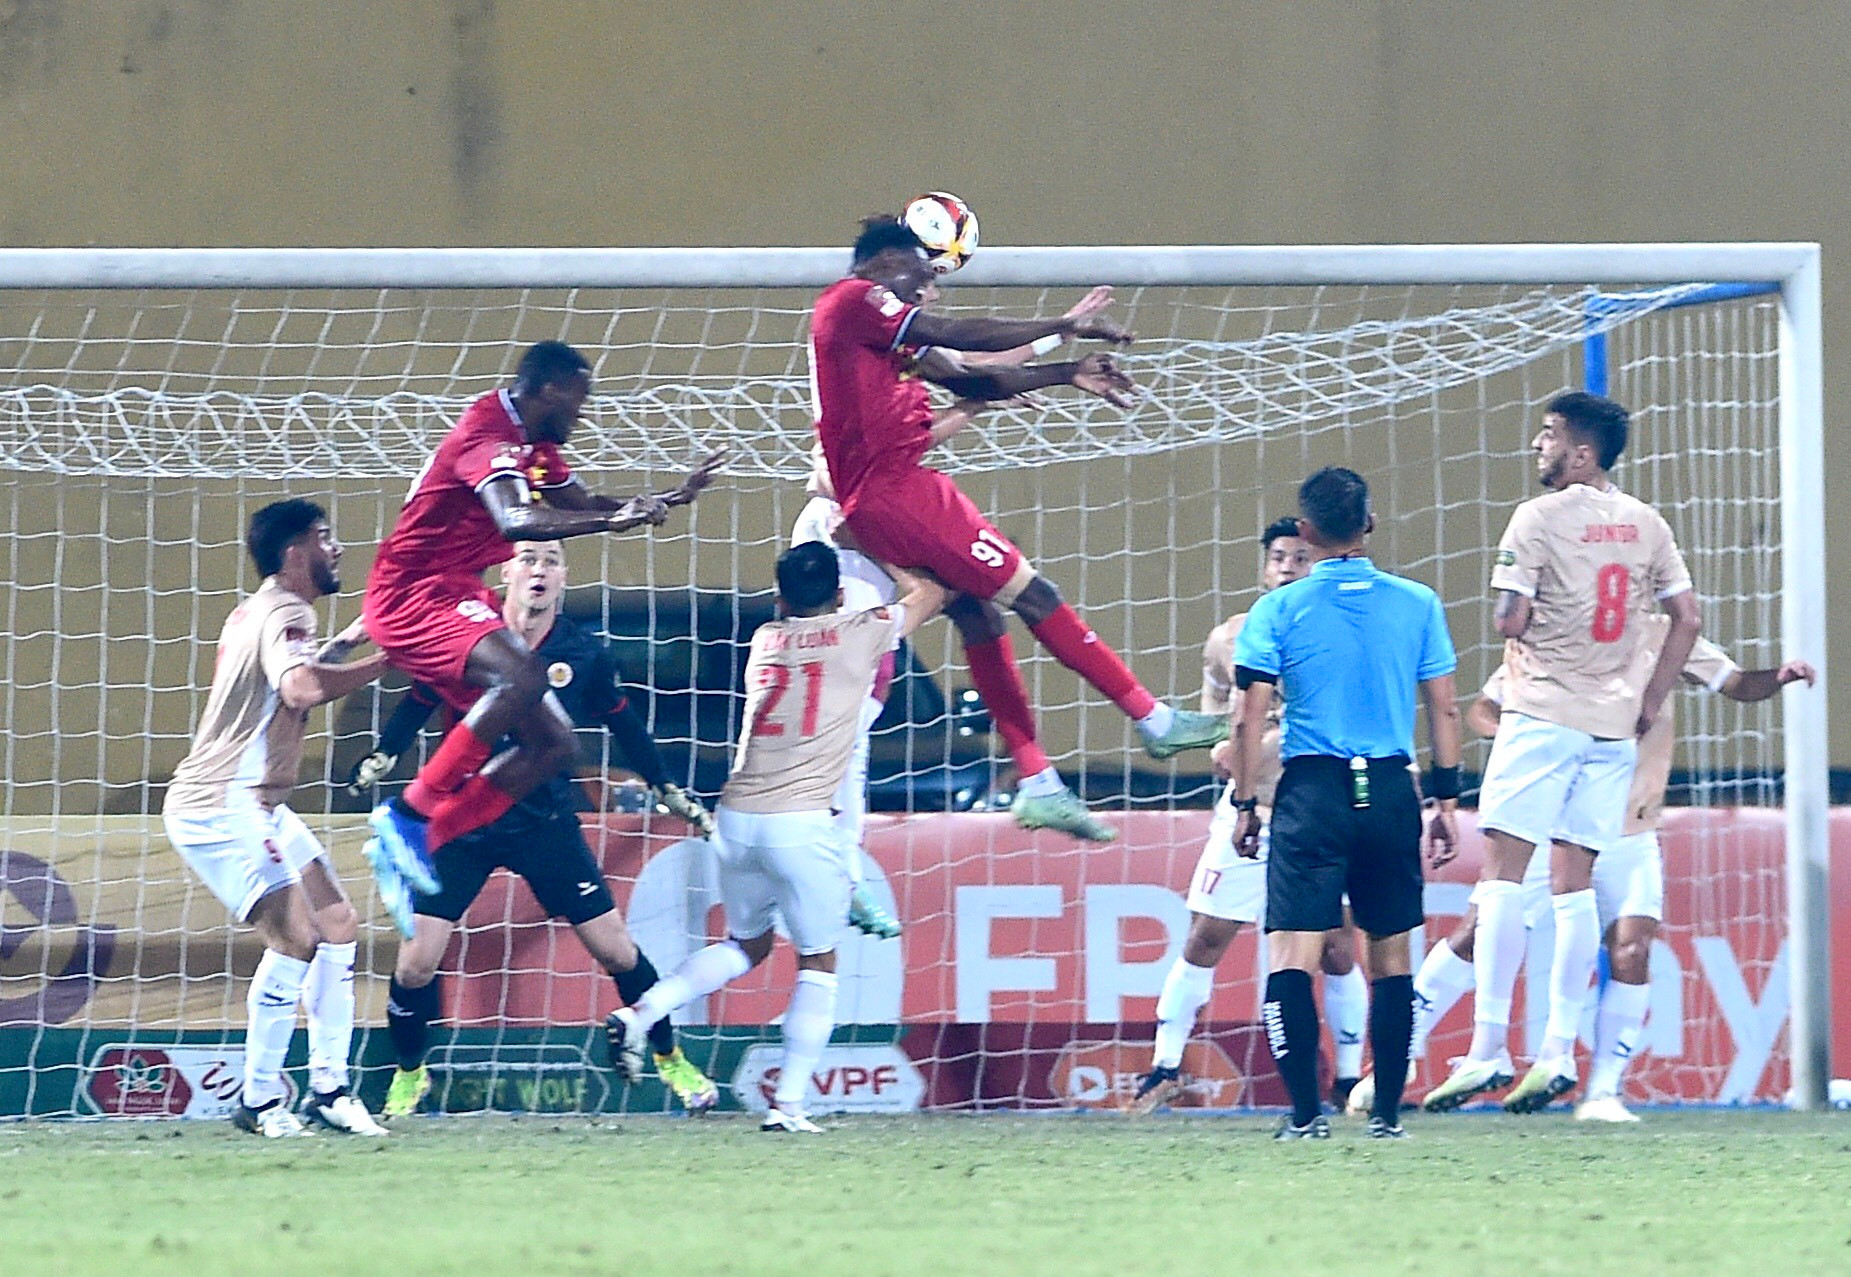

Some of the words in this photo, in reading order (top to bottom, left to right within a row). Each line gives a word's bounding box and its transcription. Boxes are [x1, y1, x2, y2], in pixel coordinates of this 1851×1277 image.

[970, 529, 1010, 567] 91
[1591, 563, 1629, 643] 8
[751, 661, 824, 738] 21
[1201, 868, 1221, 895] 17
